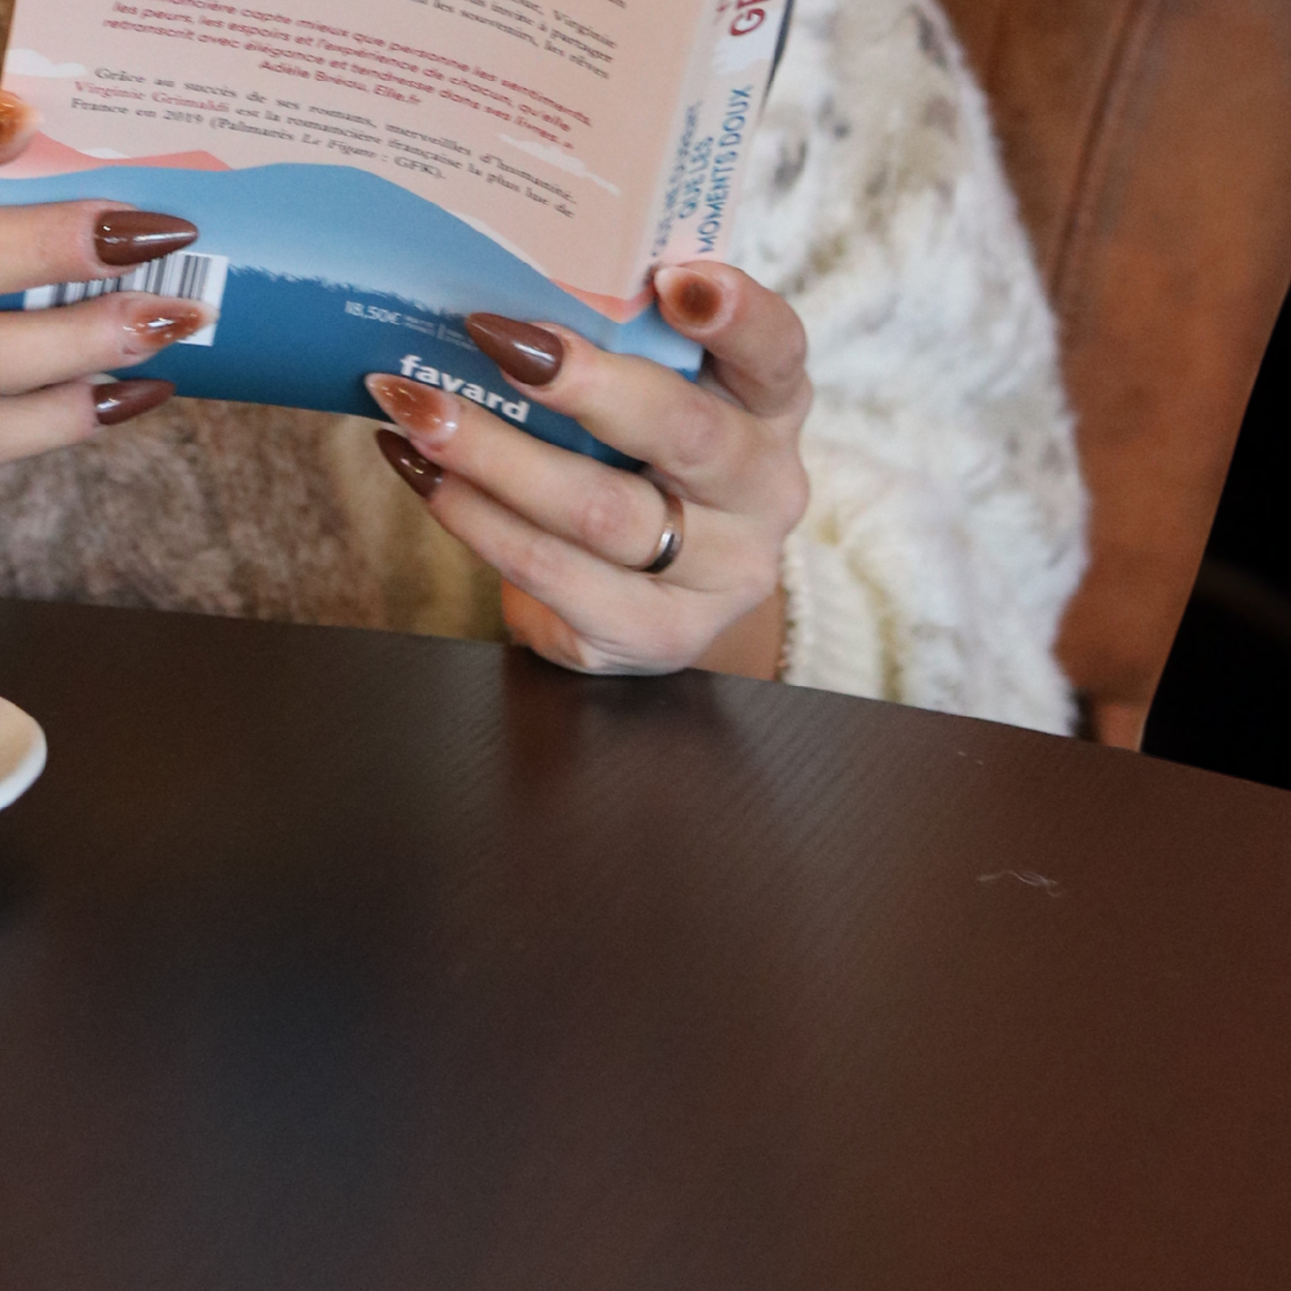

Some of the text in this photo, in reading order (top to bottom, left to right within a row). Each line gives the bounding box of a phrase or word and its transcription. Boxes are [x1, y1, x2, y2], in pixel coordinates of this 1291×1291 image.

[112, 0, 138, 14] les
[198, 14, 224, 28] les
[227, 22, 291, 40] espoirs
[294, 34, 313, 45] et
[422, 64, 444, 80] de
[240, 7, 292, 24] capte
[295, 18, 349, 37] mieux
[352, 31, 386, 46] que
[388, 40, 470, 72] personne
[472, 64, 497, 82] les
[490, 1, 533, 26] invite
[550, 27, 612, 64] partager
[544, 39, 565, 58] les
[552, 8, 617, 49] Virginie
[102, 19, 195, 40] retranscrit
[197, 33, 240, 48] avec
[329, 59, 347, 70] et
[350, 62, 435, 94] tendresse
[438, 86, 481, 110] dans
[483, 105, 511, 122] ses
[71, 95, 128, 113] France
[135, 107, 157, 117] en
[163, 108, 204, 124] 2019
[154, 78, 175, 88] au
[246, 89, 267, 103] de
[275, 98, 300, 109] ses
[384, 123, 471, 157] merveilles
[74, 79, 145, 99] Virginie
[151, 90, 230, 112] Grimaldi
[235, 106, 259, 117] est
[264, 108, 281, 121] la
[467, 162, 482, 177] la
[486, 172, 520, 193] plus
[554, 199, 573, 218] de
[696, 85, 755, 254] MOMENTS DOUX
